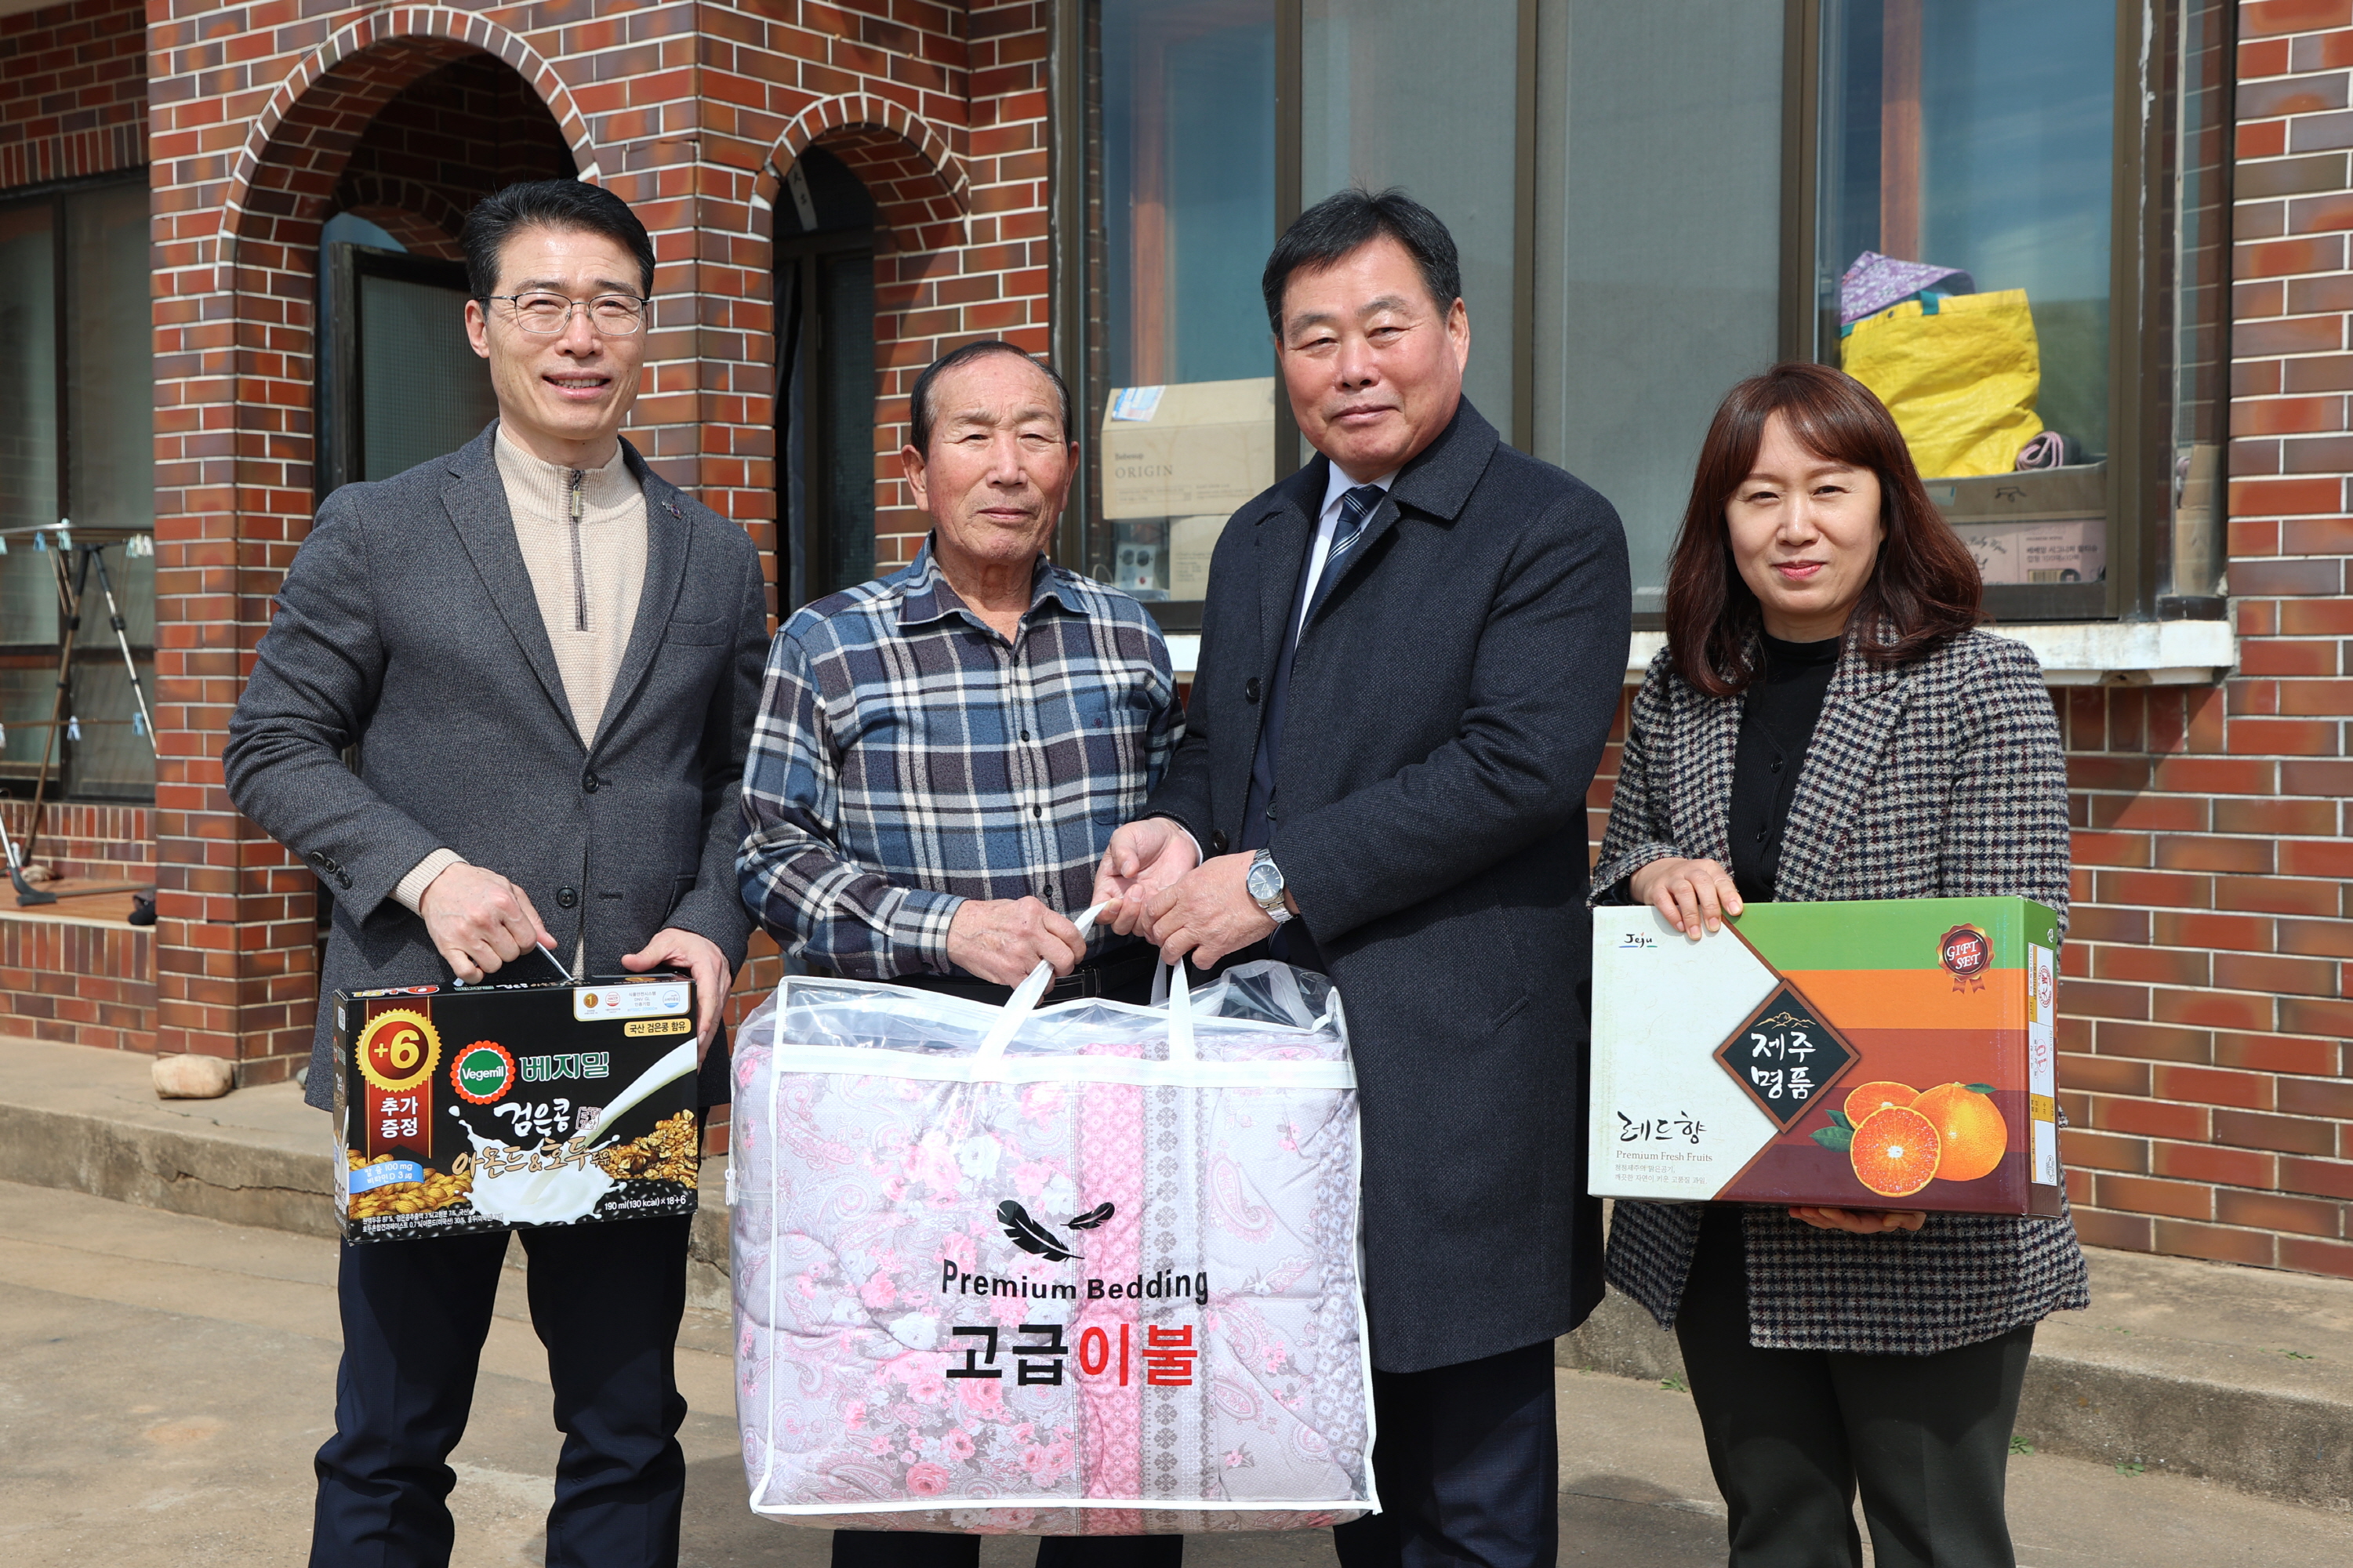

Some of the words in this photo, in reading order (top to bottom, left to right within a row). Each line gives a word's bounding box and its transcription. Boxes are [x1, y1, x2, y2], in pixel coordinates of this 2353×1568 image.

[1115, 465, 1173, 479] ORIGIN
[1624, 932, 1652, 949] Jeju
[1946, 939, 1979, 961] GIFT
[1955, 952, 1981, 970] SET
[630, 1024, 645, 1033] 국산
[647, 1022, 669, 1033] 검은콩
[671, 1021, 686, 1031] 함유
[373, 1029, 420, 1069] +6
[1751, 1031, 1816, 1062] 제주
[462, 1065, 504, 1081] Vegemil
[519, 1051, 609, 1082] 베지밀
[1751, 1066, 1815, 1099] 명품
[380, 1096, 419, 1116] 추가
[380, 1116, 418, 1138] 증정
[493, 1098, 571, 1137] 검은콩
[1617, 1110, 1708, 1144] 레드향
[1616, 1150, 1658, 1160] Premium
[1661, 1152, 1684, 1160] Fresh
[1687, 1152, 1713, 1162] Fruits
[385, 1163, 398, 1171] 100
[398, 1171, 404, 1179] 3
[1648, 1165, 1676, 1174] 맑은공기,
[363, 1216, 381, 1225] 원액두유
[397, 1212, 423, 1222] 검은콩추출액
[942, 1259, 1077, 1299] Premium
[1088, 1269, 1208, 1305] Bedding
[946, 1323, 1198, 1386] 고급이불
